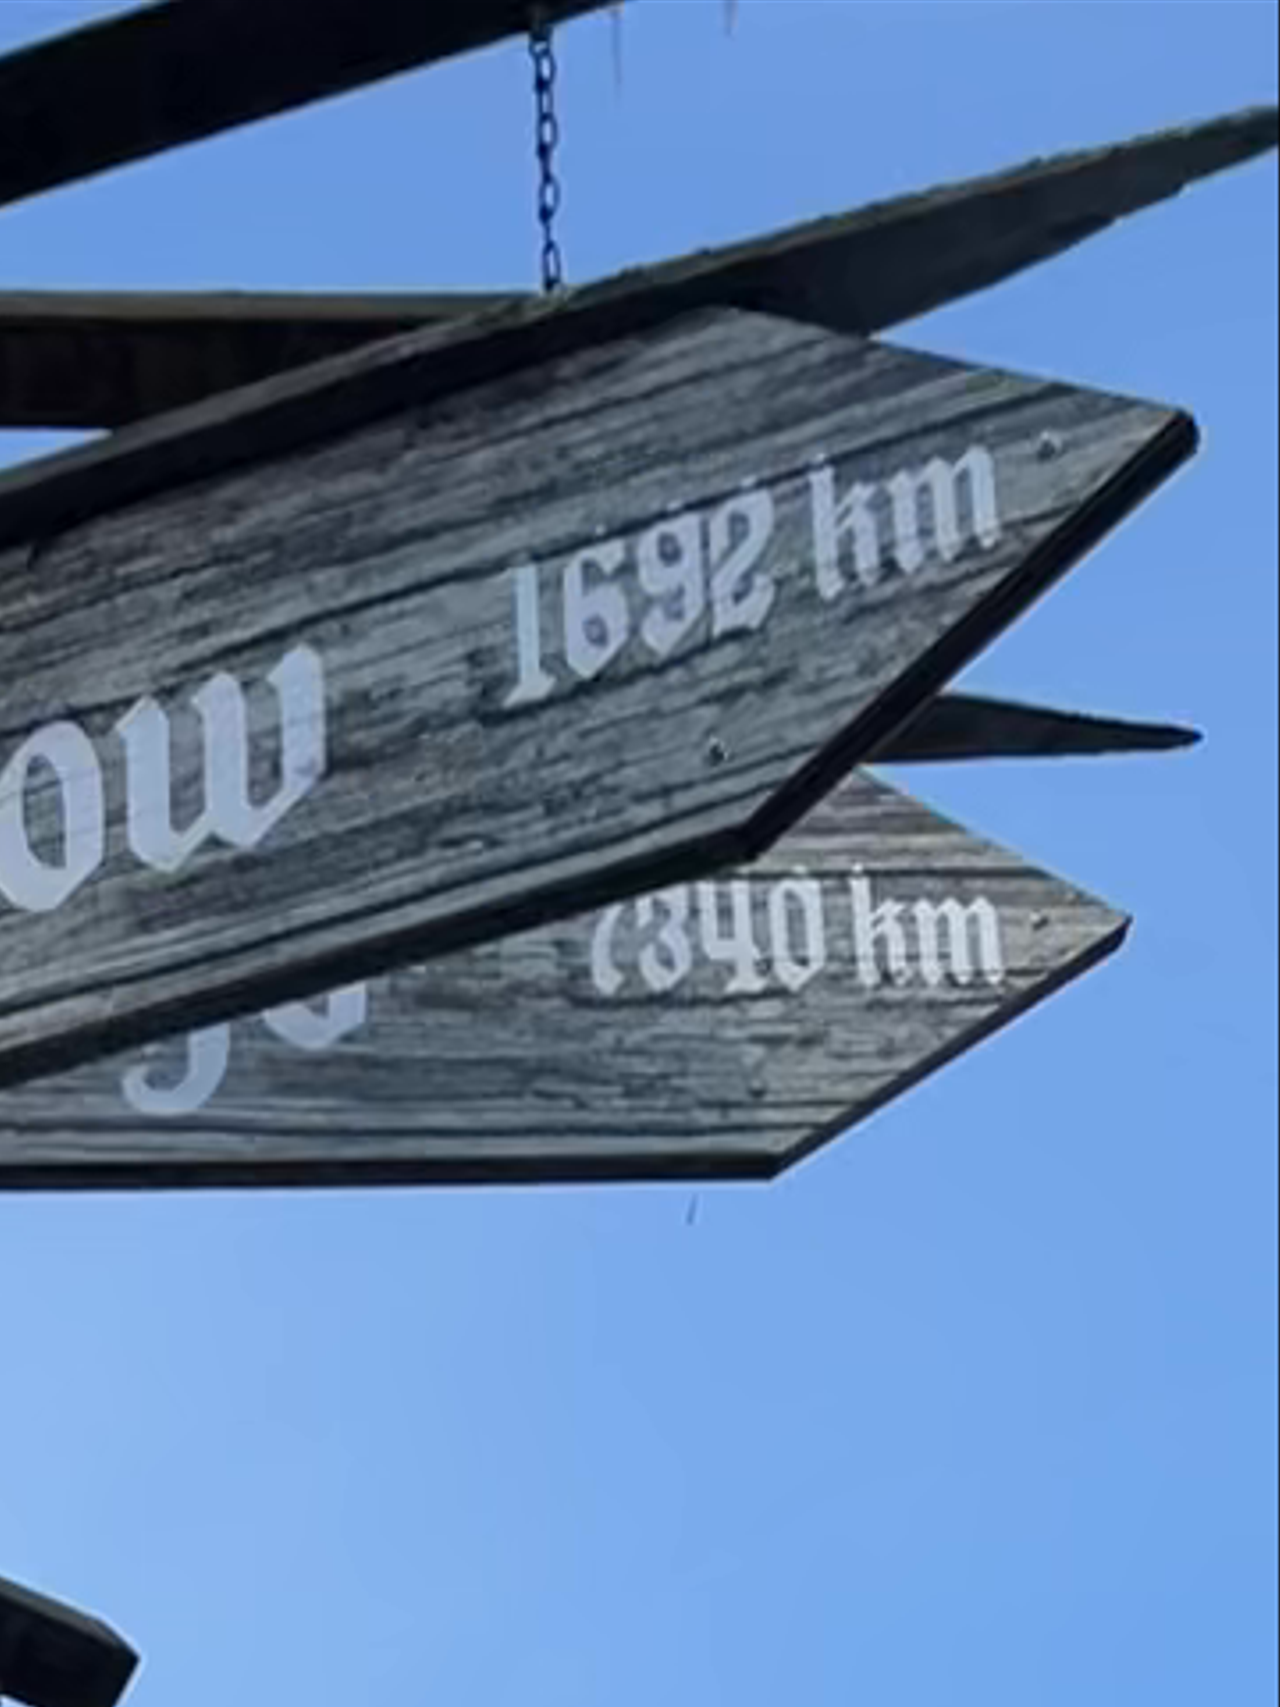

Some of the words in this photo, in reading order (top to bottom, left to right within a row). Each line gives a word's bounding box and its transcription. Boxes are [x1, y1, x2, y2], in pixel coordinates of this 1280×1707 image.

[503, 478, 776, 708] 1692
[808, 445, 1002, 601] km
[589, 868, 829, 995] 7340
[851, 864, 1004, 988] km
